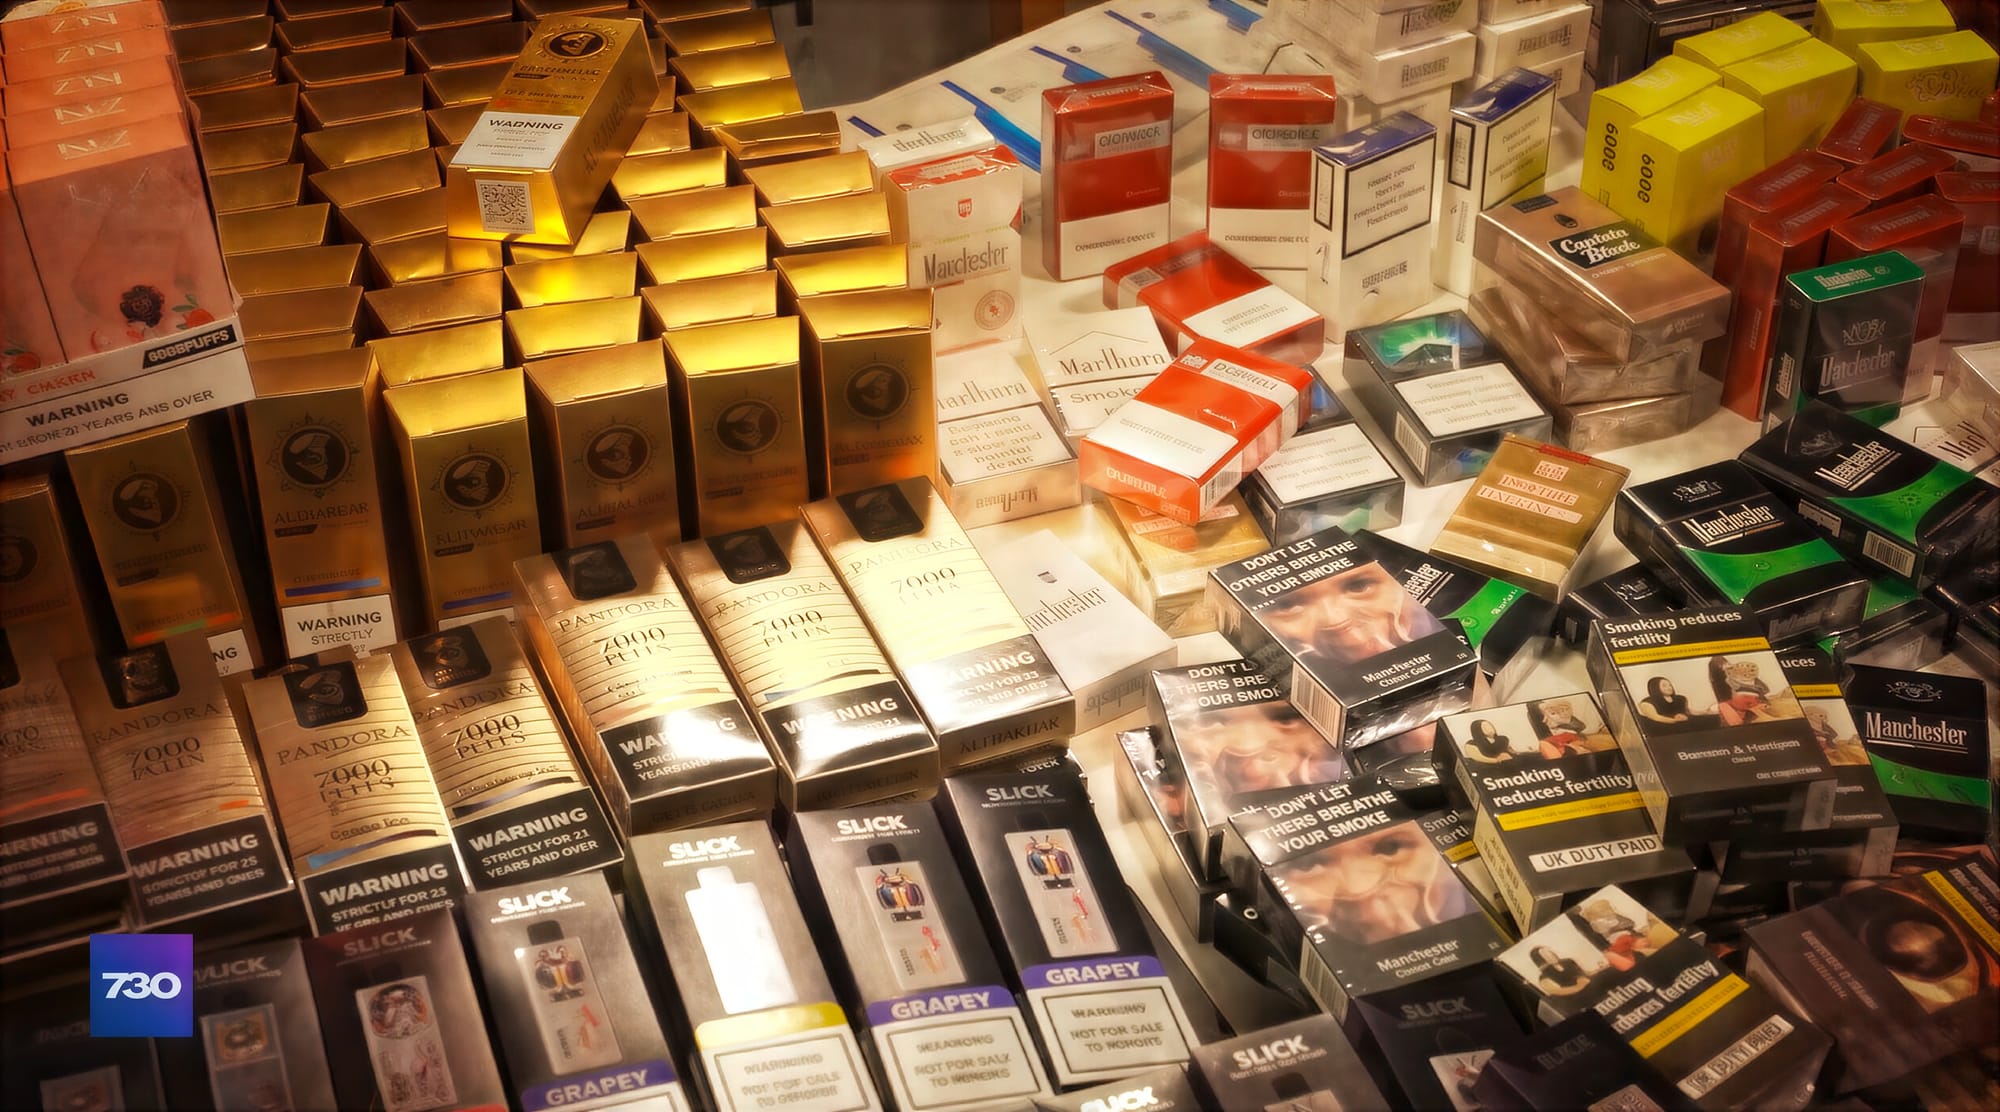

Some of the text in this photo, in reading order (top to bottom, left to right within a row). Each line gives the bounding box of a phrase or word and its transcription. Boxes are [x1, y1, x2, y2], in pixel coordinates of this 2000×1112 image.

[25, 392, 130, 428] WARNING
[83, 410, 135, 433] YEARS
[173, 389, 216, 410] OVER
[1288, 540, 1358, 572] BREATHE
[1291, 537, 1317, 556] LET
[1256, 574, 1301, 598] YOUR
[296, 610, 383, 634] WARNING
[1682, 609, 1742, 628] reduces
[1610, 630, 1672, 650] fertility
[948, 649, 1036, 685] ARNING
[1780, 655, 1817, 671] uces
[1175, 677, 1230, 696] THERS
[1198, 691, 1234, 708] OUR
[276, 725, 412, 766] PANDORA
[985, 783, 1055, 802] SLICK
[1320, 783, 1354, 802] LET
[1492, 772, 1634, 808] reduces fertility
[467, 805, 590, 853] WARNING
[835, 814, 909, 836] SLICK
[1259, 789, 1398, 840] THERS BREATHE
[667, 835, 743, 860] SLICK
[1278, 811, 1392, 854] YOUR SMOKE
[130, 832, 260, 880] WARNING
[481, 838, 543, 867] STRICTLY
[543, 832, 572, 849] FOR
[485, 838, 600, 881] YEARS AND OVER
[1540, 837, 1658, 871] UK DUTY PAID
[319, 862, 450, 906] WARNING
[497, 885, 572, 915] SLICK
[342, 926, 418, 957] SLICK
[1375, 938, 1460, 974] Manchester
[1044, 960, 1141, 986] GRAPEY
[889, 990, 992, 1021] GRAPEY
[1232, 1033, 1311, 1070] SLICK
[544, 1068, 650, 1107] GRAPEY
